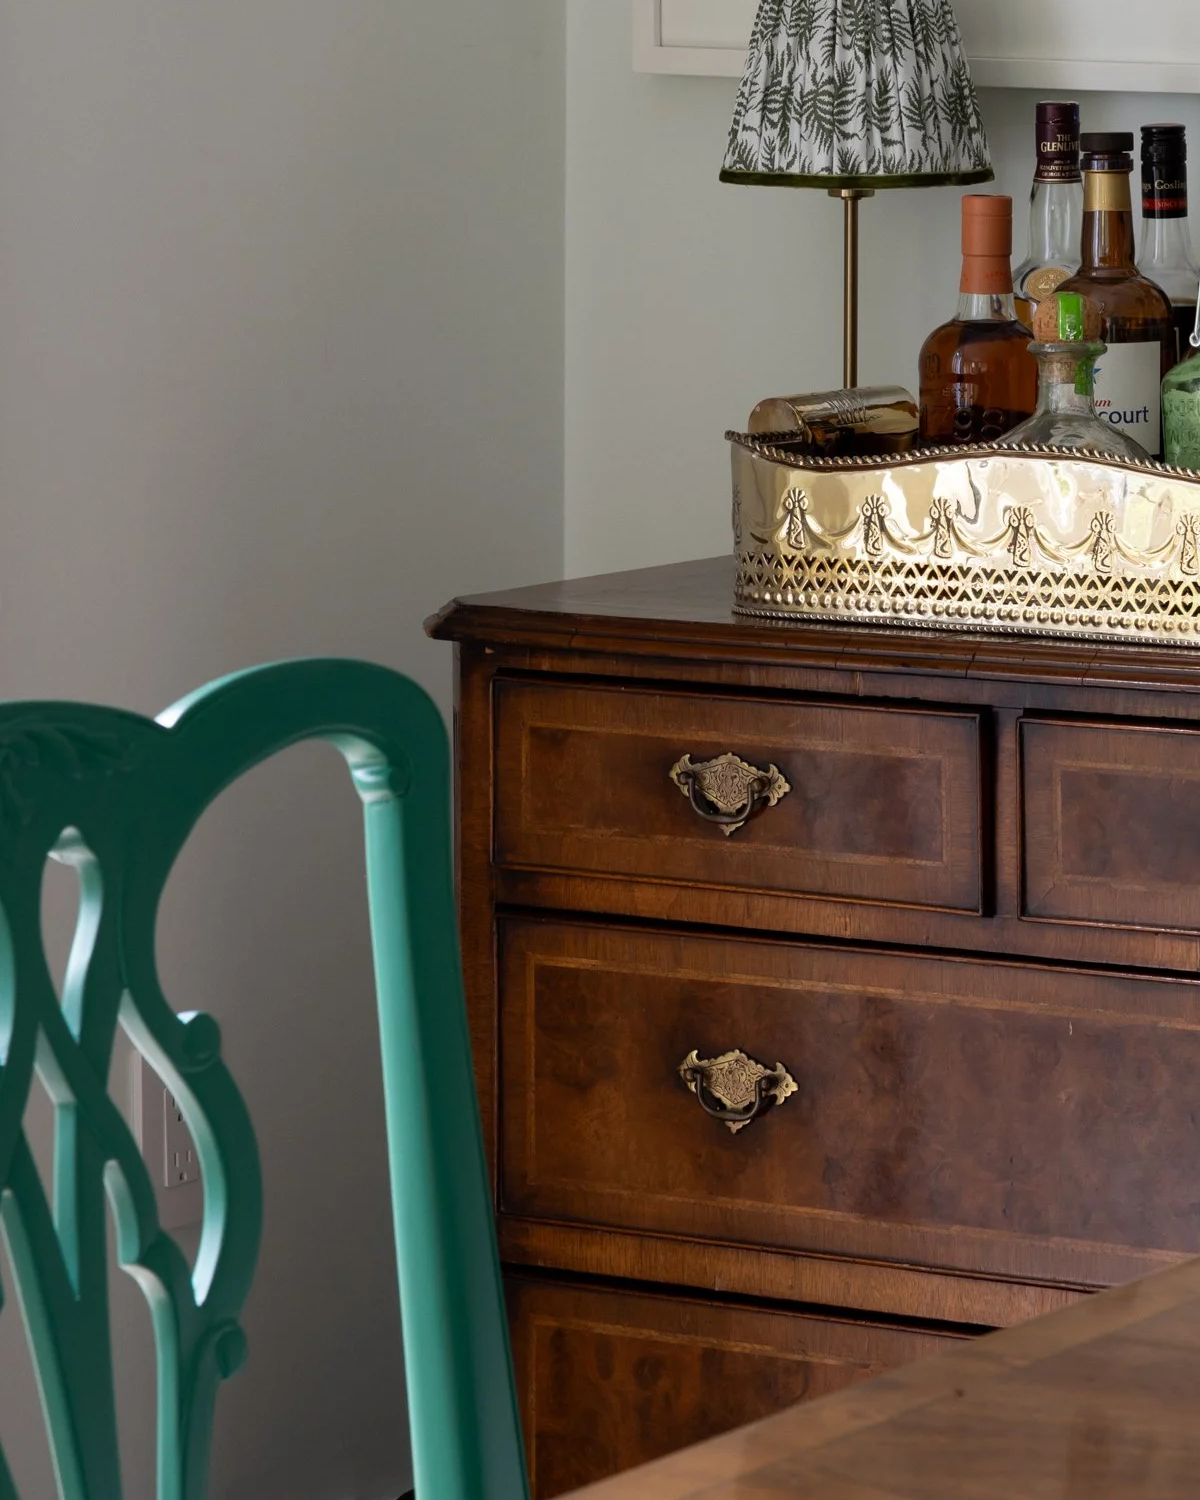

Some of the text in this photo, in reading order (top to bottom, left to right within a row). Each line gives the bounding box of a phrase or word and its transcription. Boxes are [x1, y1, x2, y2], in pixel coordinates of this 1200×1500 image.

[1056, 134, 1071, 142] THE
[1041, 141, 1079, 152] GLENLIV
[1154, 180, 1186, 190] Goslin
[1094, 399, 1112, 407] um
